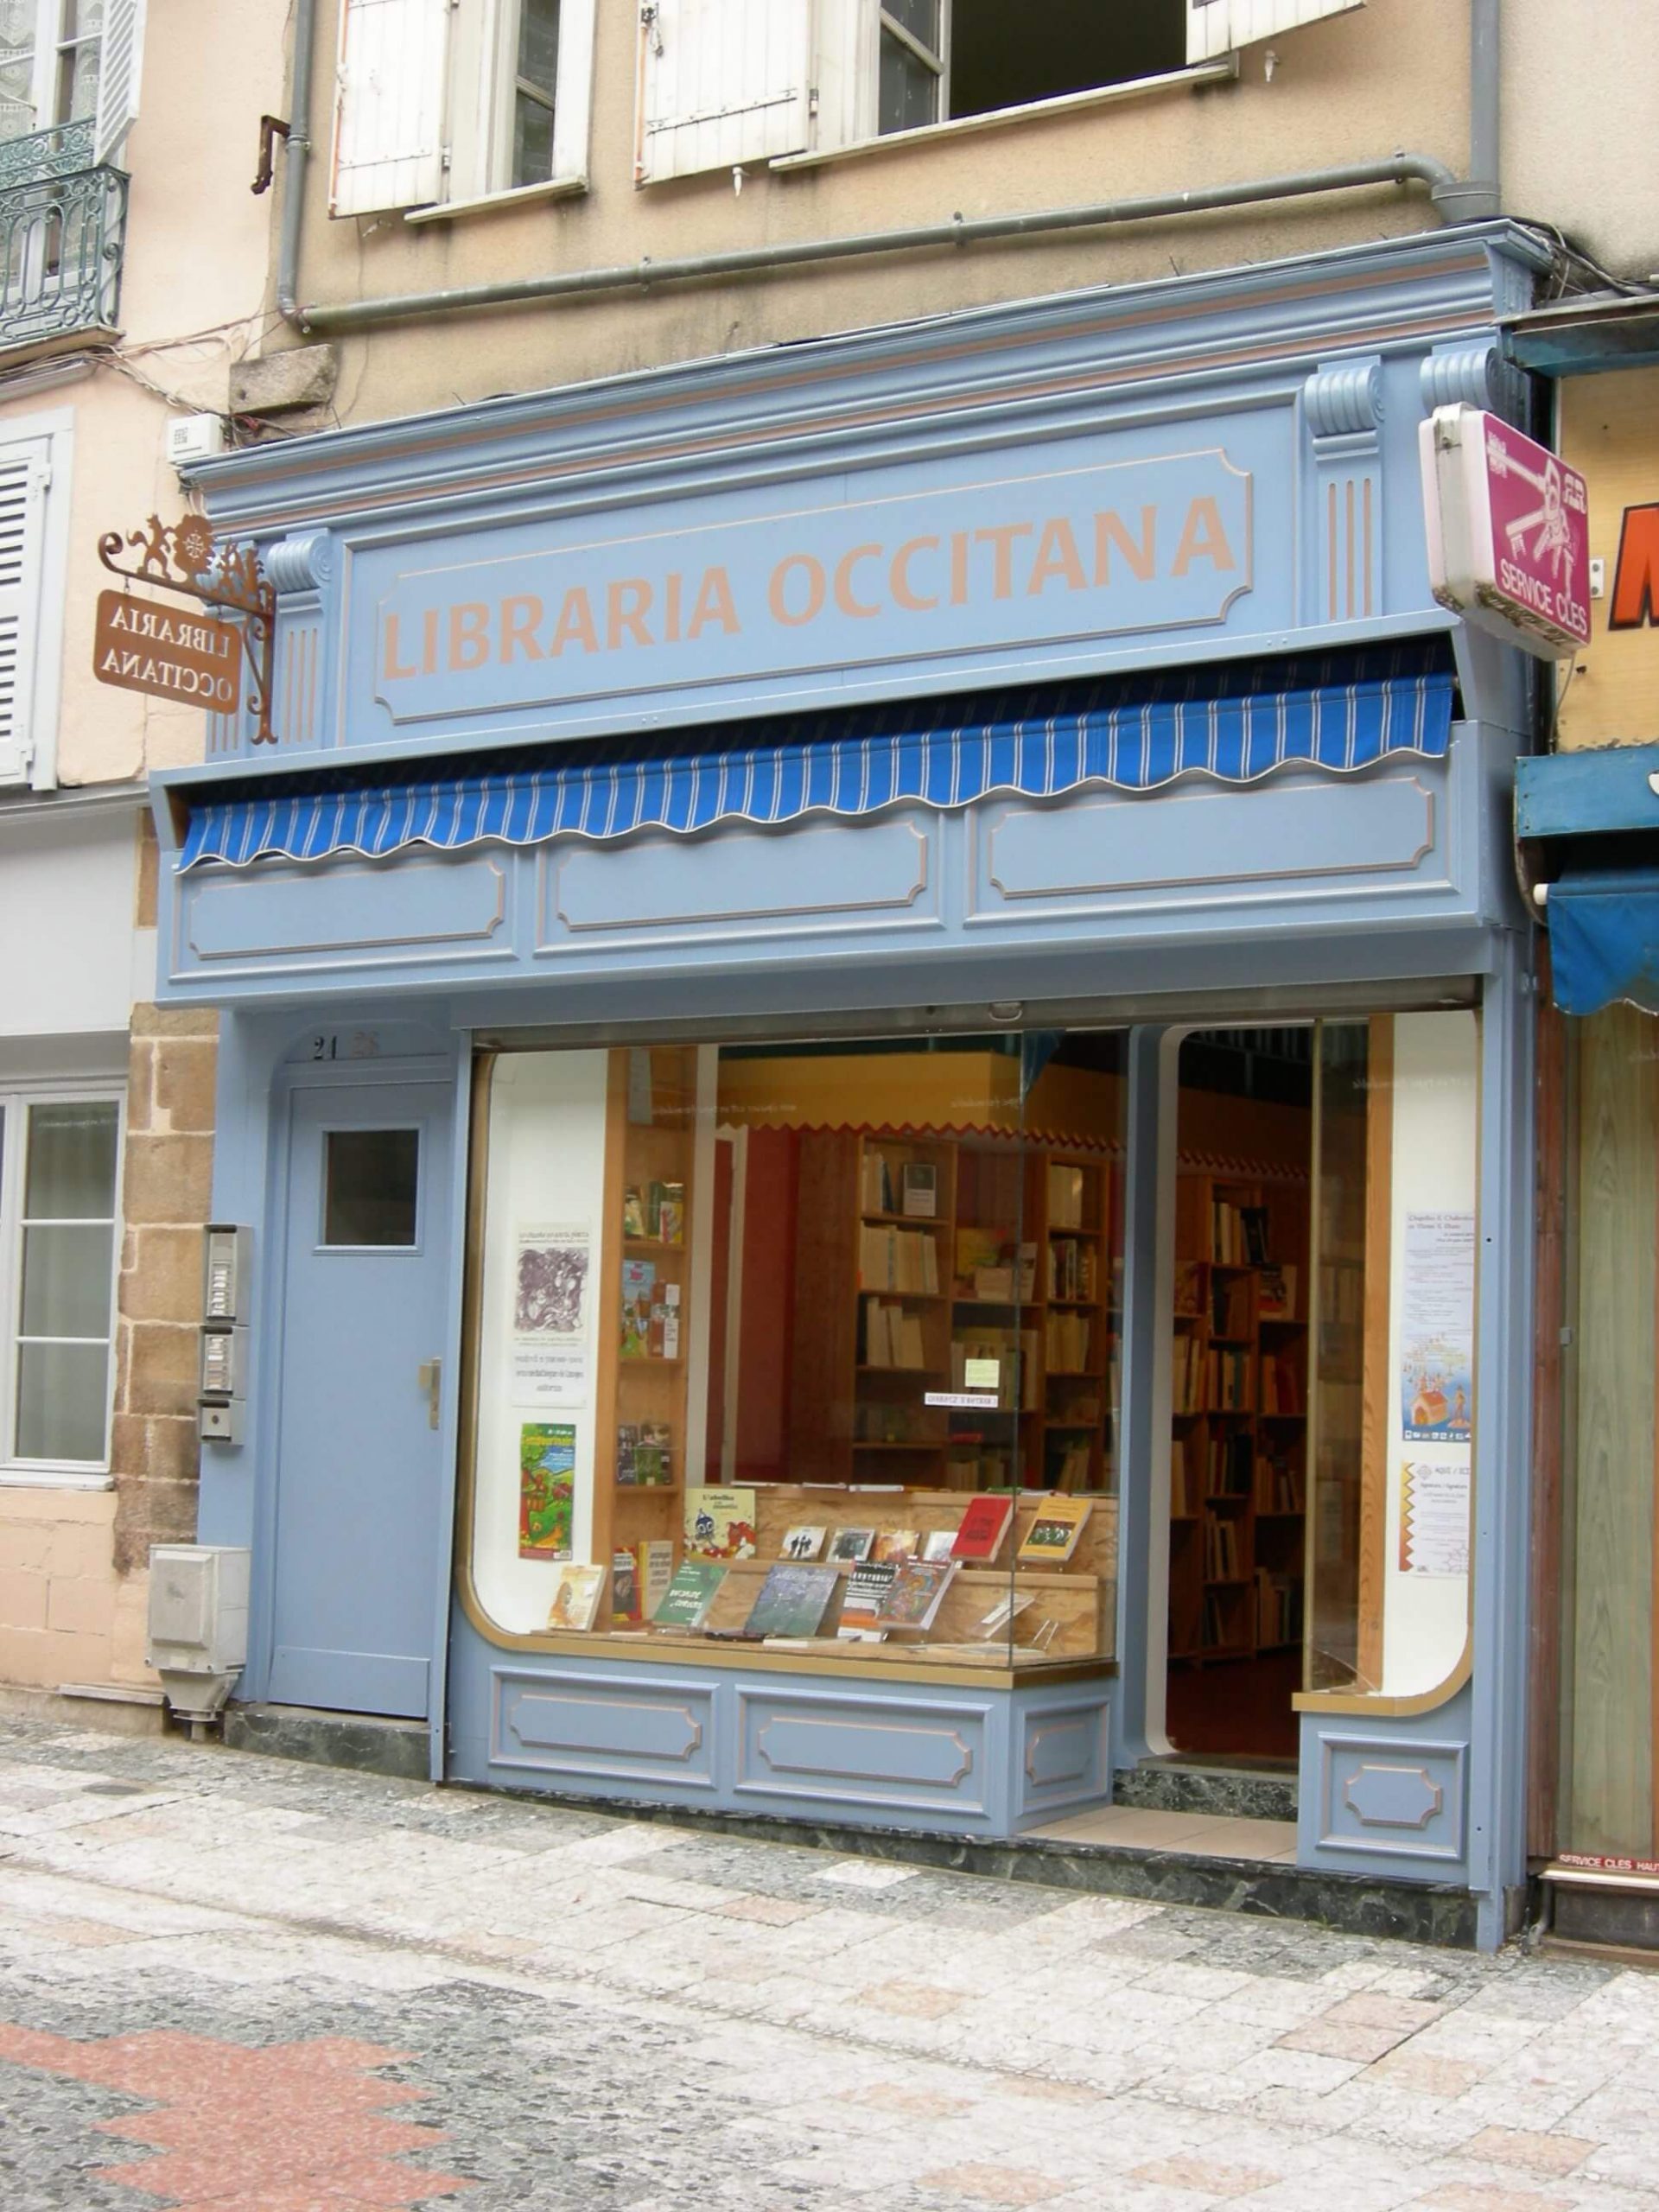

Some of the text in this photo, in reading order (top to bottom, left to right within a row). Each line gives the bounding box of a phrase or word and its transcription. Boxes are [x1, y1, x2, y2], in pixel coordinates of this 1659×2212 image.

[384, 495, 1236, 680] LIBRARIA OCCITANA
[1500, 558, 1587, 635] SERVICE CLES
[313, 1035, 338, 1061] 21
[1559, 1853, 1602, 1867] SERVICE
[1605, 1859, 1632, 1870] CLES
